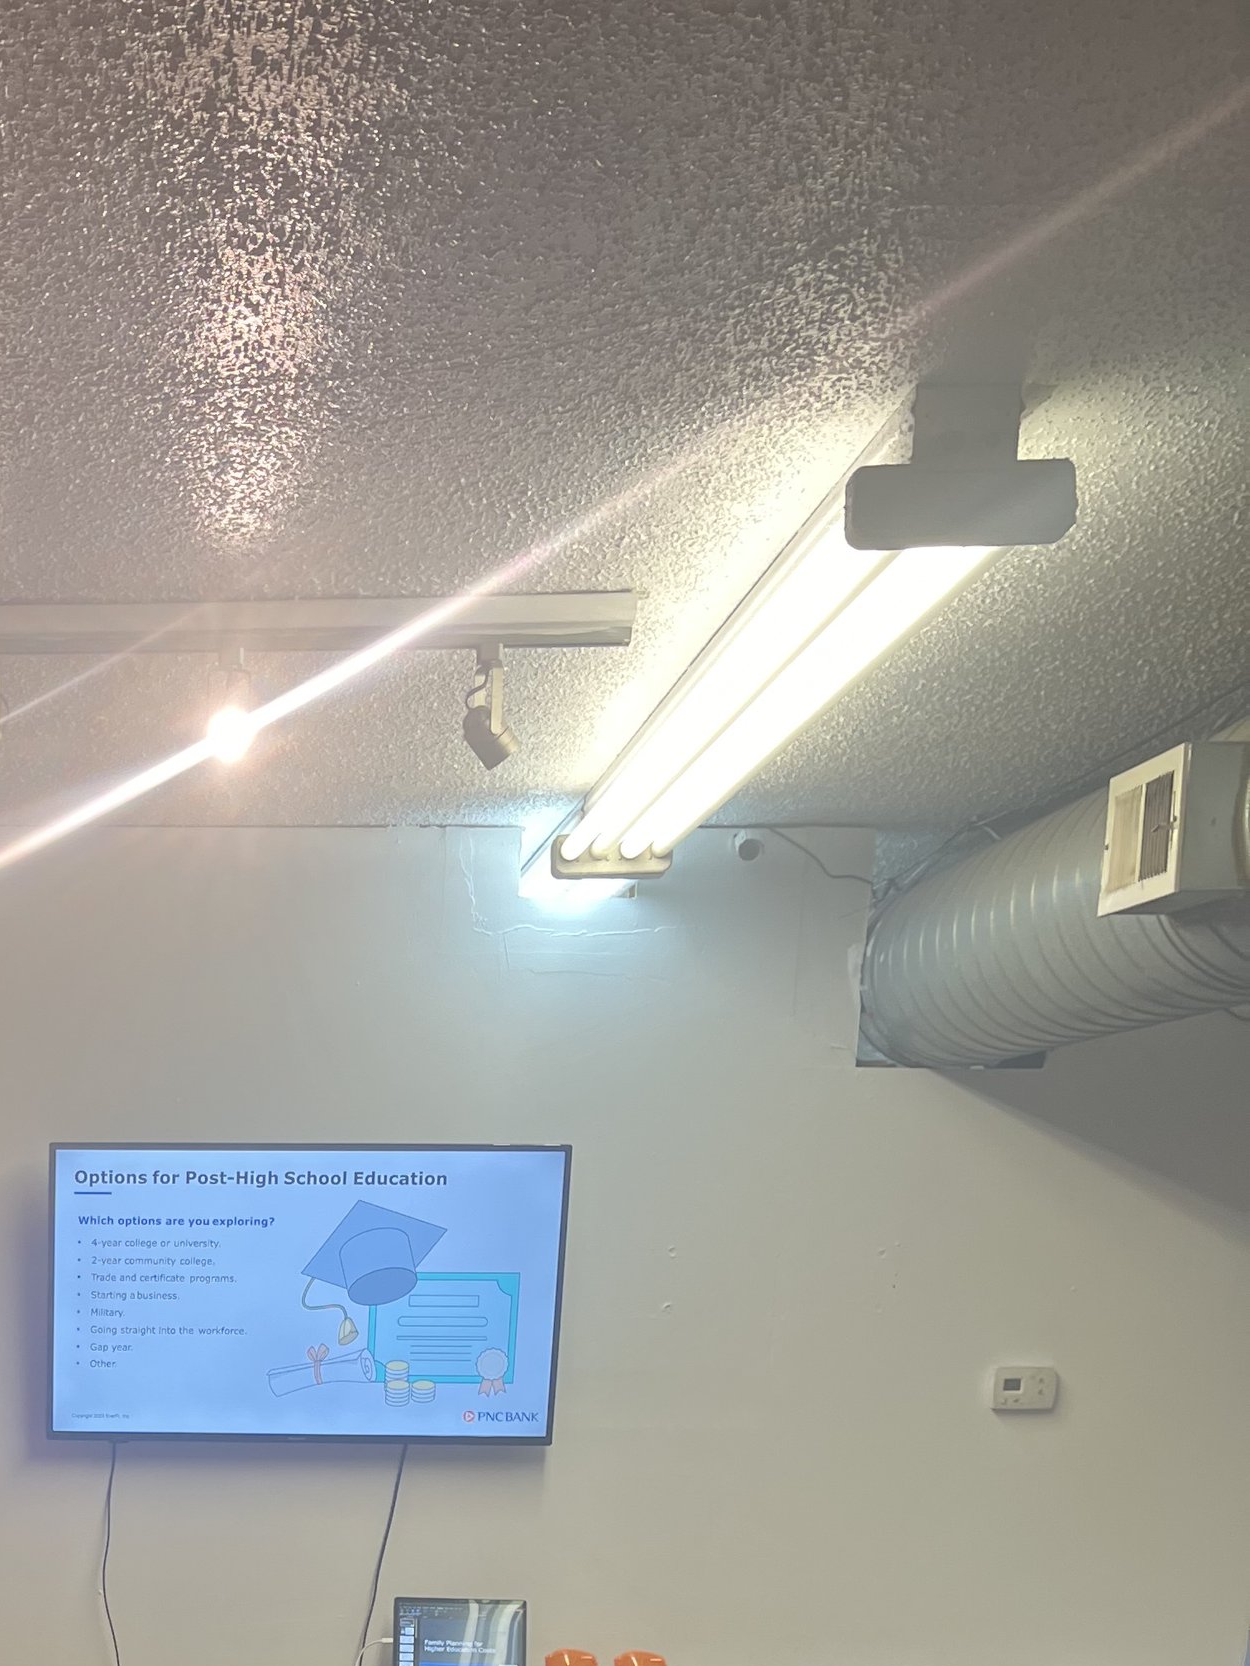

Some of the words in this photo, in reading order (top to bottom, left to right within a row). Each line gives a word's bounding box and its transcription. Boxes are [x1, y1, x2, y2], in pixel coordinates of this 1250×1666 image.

[74, 1170, 148, 1188] Options
[152, 1170, 180, 1184] for
[185, 1170, 279, 1188] Post-High
[284, 1170, 347, 1186] School
[353, 1170, 448, 1186] Education
[78, 1216, 114, 1226] Which
[117, 1216, 162, 1228] options
[165, 1217, 185, 1226] are
[188, 1217, 210, 1228] you
[212, 1216, 275, 1228] exploring?
[91, 1238, 122, 1249] 4-year
[124, 1238, 158, 1250] college
[160, 1240, 171, 1248] or
[173, 1238, 222, 1249] university.
[91, 1256, 122, 1266] 2-year
[124, 1256, 177, 1267] community
[179, 1256, 216, 1267] college.
[91, 1273, 117, 1282] Trade
[119, 1273, 137, 1282] and
[139, 1273, 185, 1283] certificate
[189, 1274, 238, 1284] programs.
[90, 1291, 127, 1301] Starting
[90, 1325, 117, 1335] Going
[120, 1325, 156, 1336] straight
[158, 1326, 176, 1335] into
[178, 1326, 194, 1335] the
[197, 1326, 248, 1336] workforce.
[90, 1343, 109, 1353] Gap
[477, 1411, 504, 1422] PNC
[505, 1411, 539, 1422] BANK
